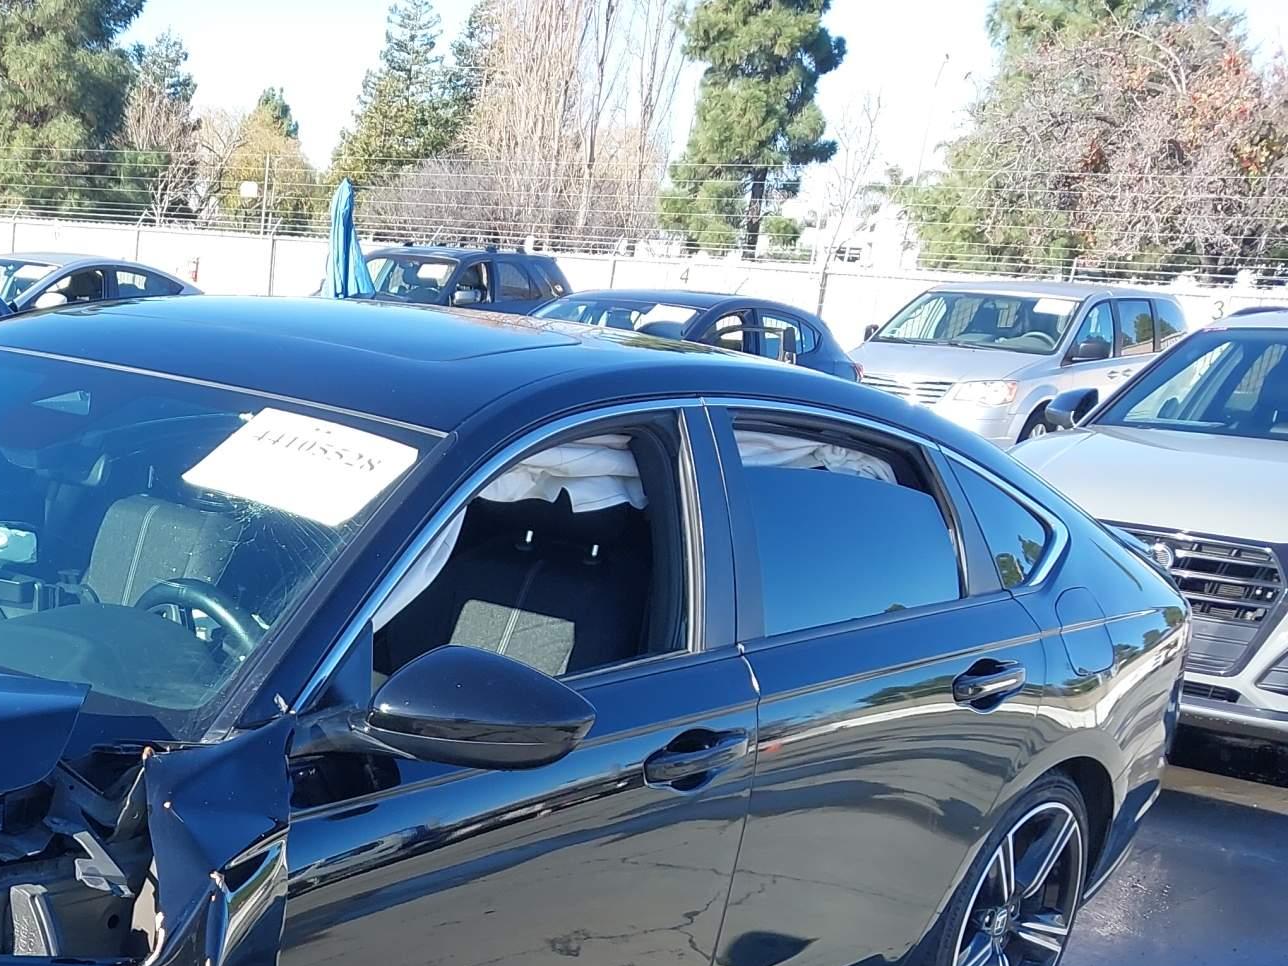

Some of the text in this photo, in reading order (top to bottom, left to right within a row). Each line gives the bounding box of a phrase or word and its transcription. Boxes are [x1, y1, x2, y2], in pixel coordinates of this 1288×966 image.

[680, 267, 690, 284] 4
[1212, 300, 1224, 320] 3
[252, 429, 383, 472] 44105528
